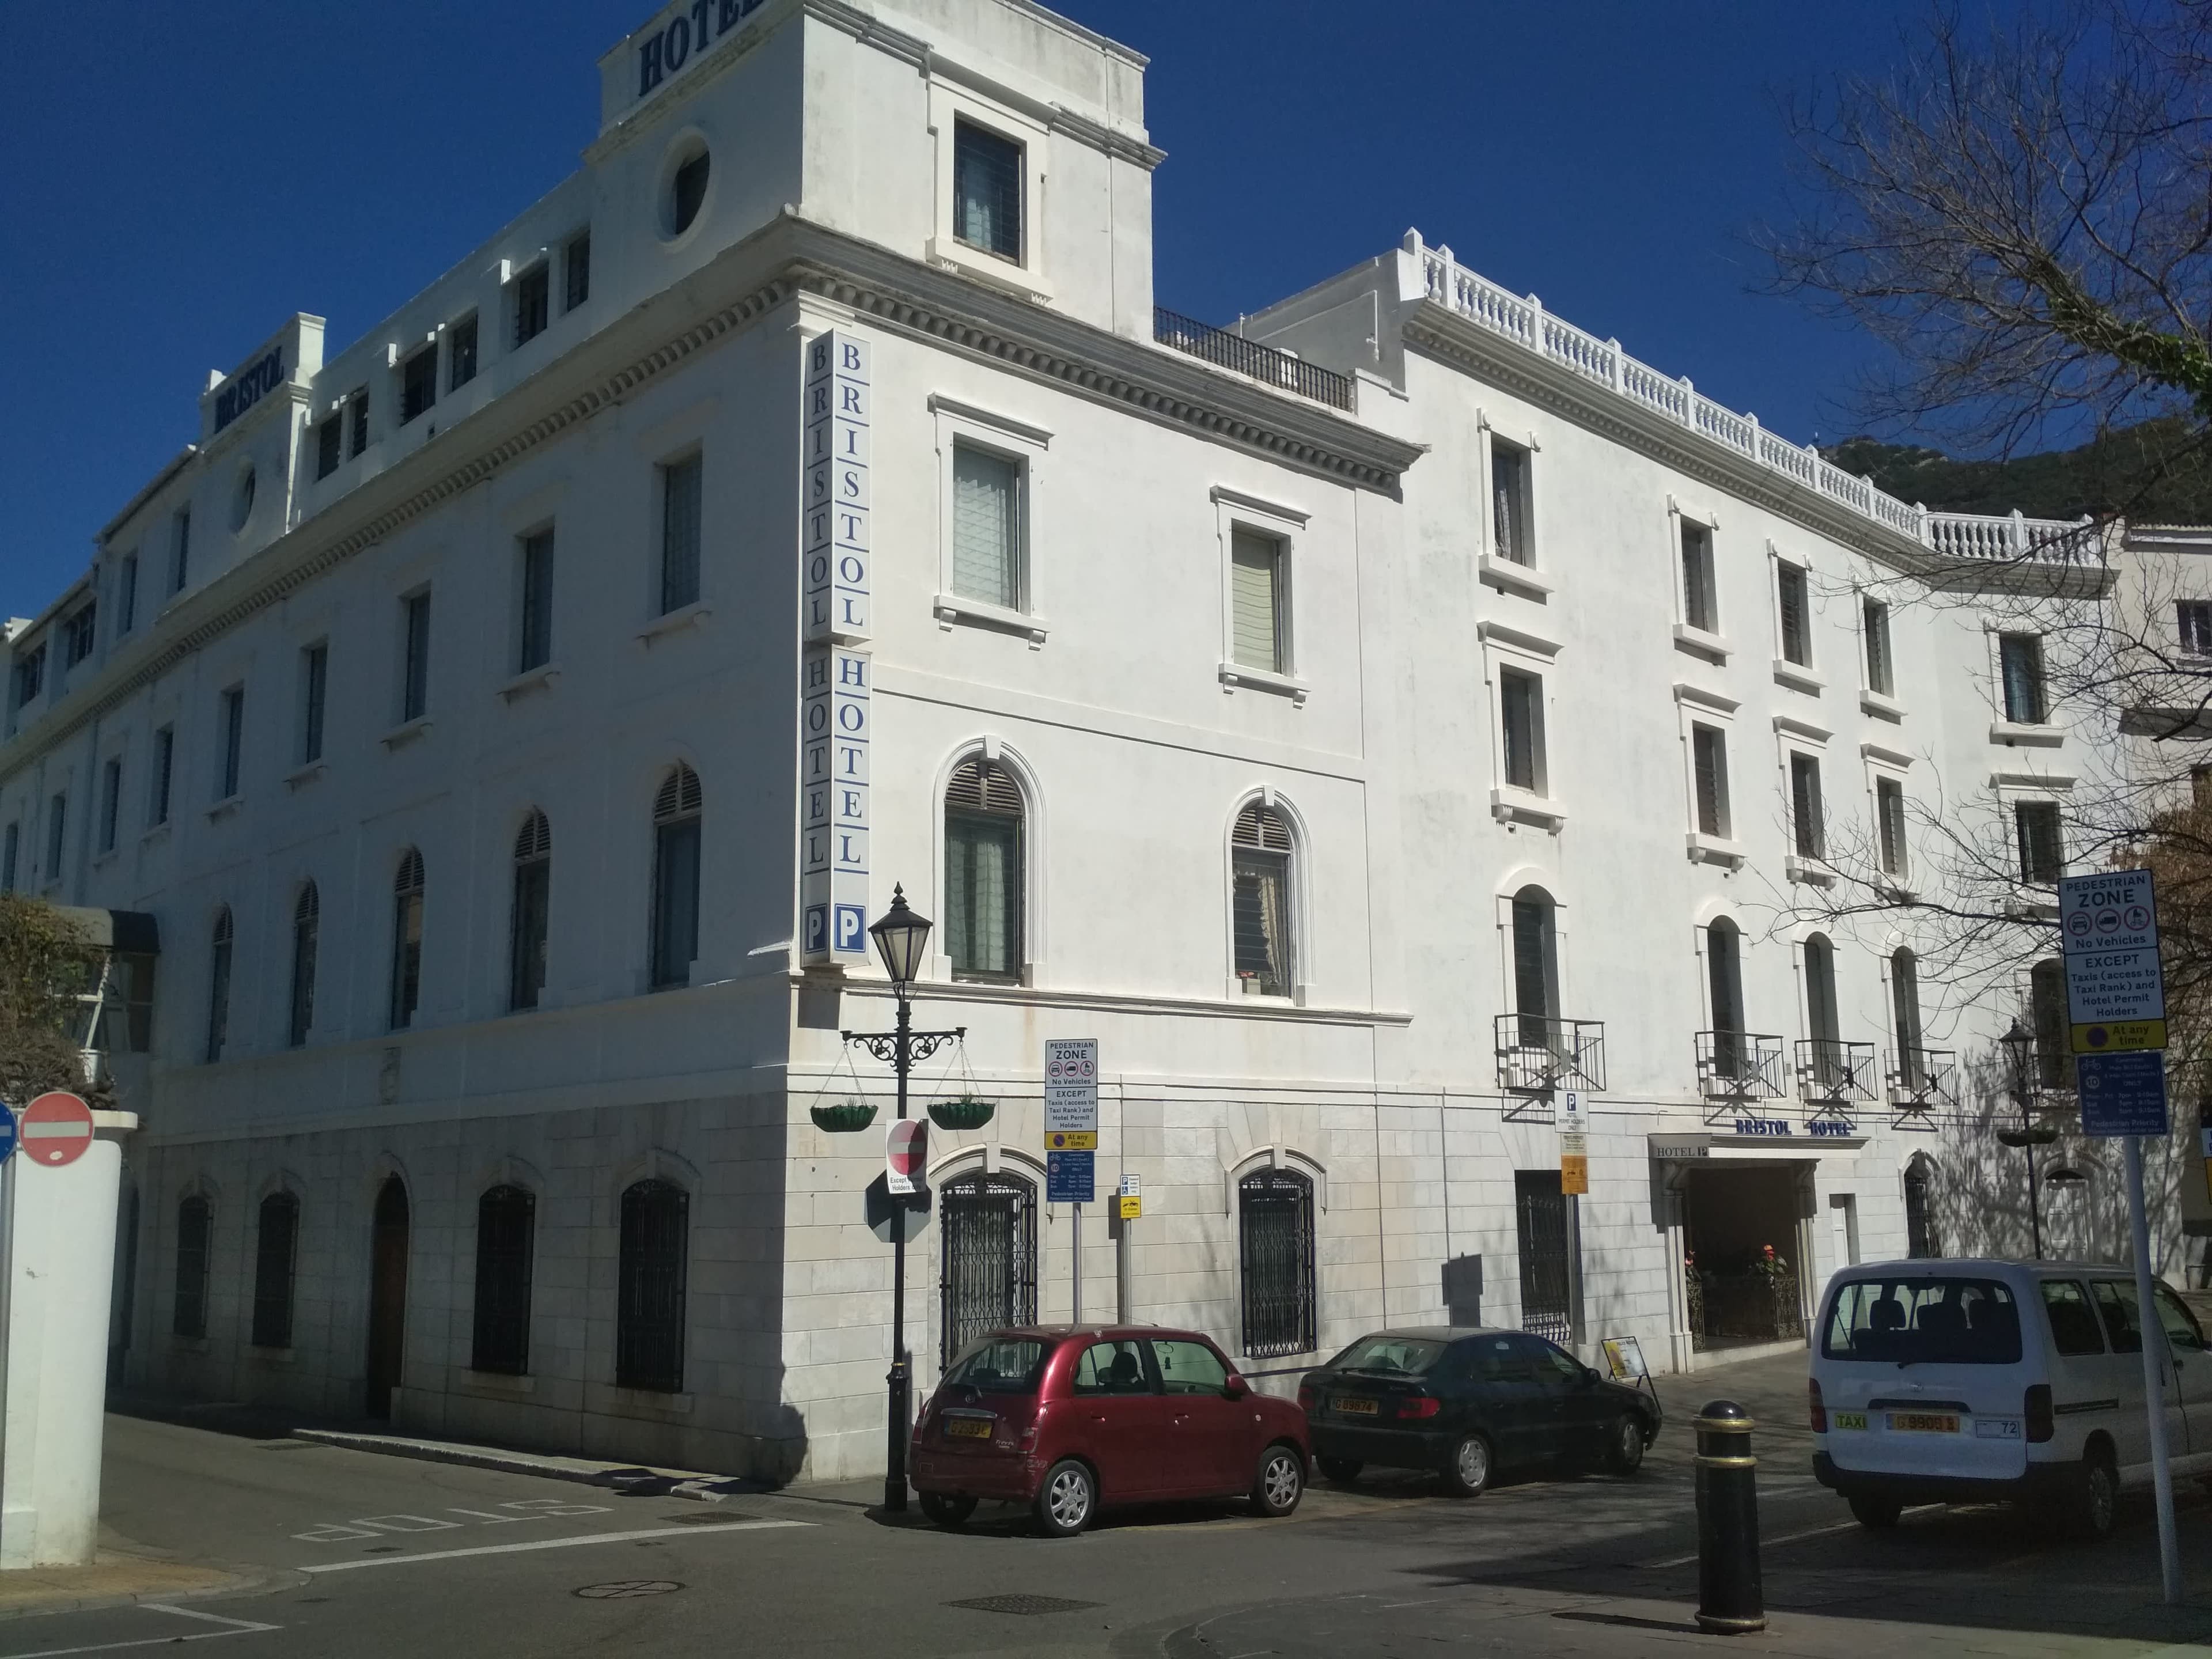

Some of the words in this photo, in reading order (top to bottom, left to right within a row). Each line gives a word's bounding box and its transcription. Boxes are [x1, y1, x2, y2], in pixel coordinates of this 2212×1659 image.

[811, 344, 827, 627] BRISTOL
[840, 342, 865, 627] BRISTOL
[809, 657, 827, 866] HOTEL
[839, 657, 866, 865] HOTEL
[2066, 875, 2145, 892] PEDESTRIAN
[2078, 889, 2135, 908] ZONE
[840, 904, 859, 946] P
[2076, 940, 2092, 949] No
[2096, 935, 2146, 946] Vehicles
[2086, 954, 2139, 968] EXCEPT
[2072, 972, 2098, 982] Taxis
[2101, 970, 2142, 980] (access
[2146, 968, 2156, 978] to
[2074, 984, 2096, 994] Taxi
[2100, 982, 2131, 993] Rank)
[2135, 980, 2155, 990] and
[2082, 995, 2111, 1006] Hotel
[2115, 993, 2150, 1003] Permit
[2097, 1007, 2138, 1017] Holders
[2112, 1025, 2125, 1035] At
[2129, 1025, 2149, 1035] any
[2120, 1036, 2145, 1046] time
[1056, 1050, 1087, 1059] ZONE
[2088, 1078, 2098, 1086] 10
[1569, 1094, 1575, 1109] P
[1736, 1119, 1792, 1135] BRISTOL
[1809, 1122, 1851, 1137] HOTEL
[1657, 1147, 1696, 1157] HOTEL
[1837, 1415, 1866, 1428] TAXI
[2001, 1422, 2017, 1434] 72
[290, 1499, 614, 1542] STOP
